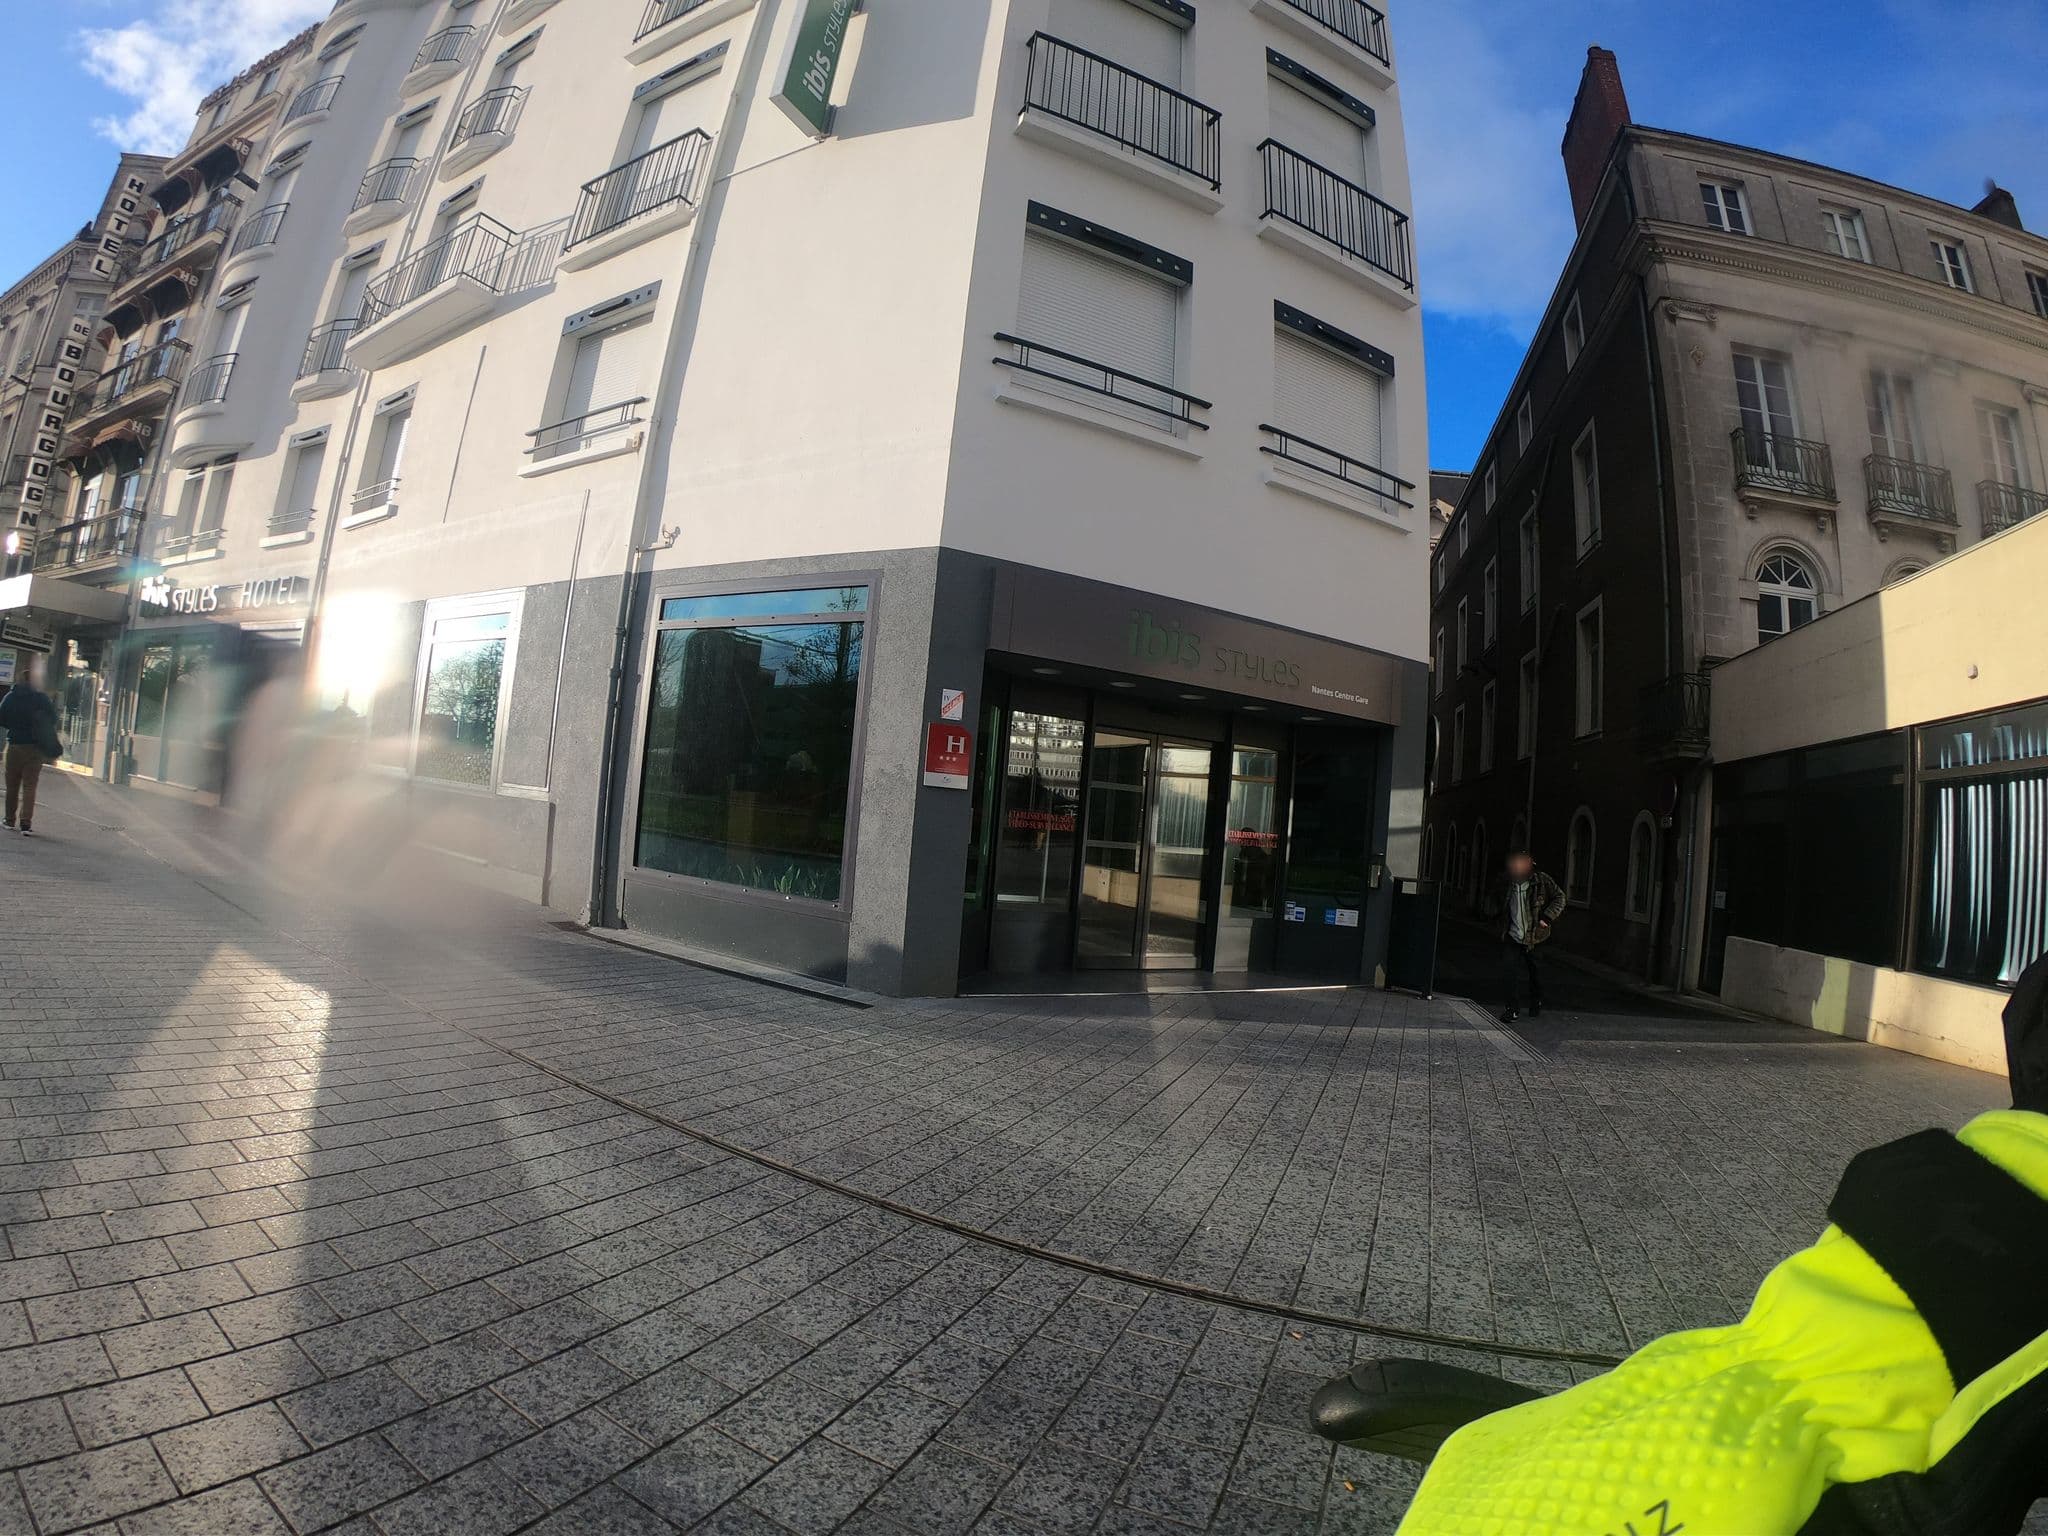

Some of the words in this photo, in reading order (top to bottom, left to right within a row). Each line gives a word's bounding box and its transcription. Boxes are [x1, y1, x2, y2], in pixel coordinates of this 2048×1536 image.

[801, 49, 831, 102] ibis
[95, 177, 146, 275] HOTEL
[73, 322, 90, 337] DE
[18, 343, 83, 551] BOURGOGNE
[239, 575, 298, 609] HOTEL
[1127, 607, 1201, 671] ibis
[1311, 685, 1334, 698] Nantes
[1334, 690, 1355, 702] Centre
[1355, 695, 1369, 705] Gare
[945, 735, 966, 755] H
